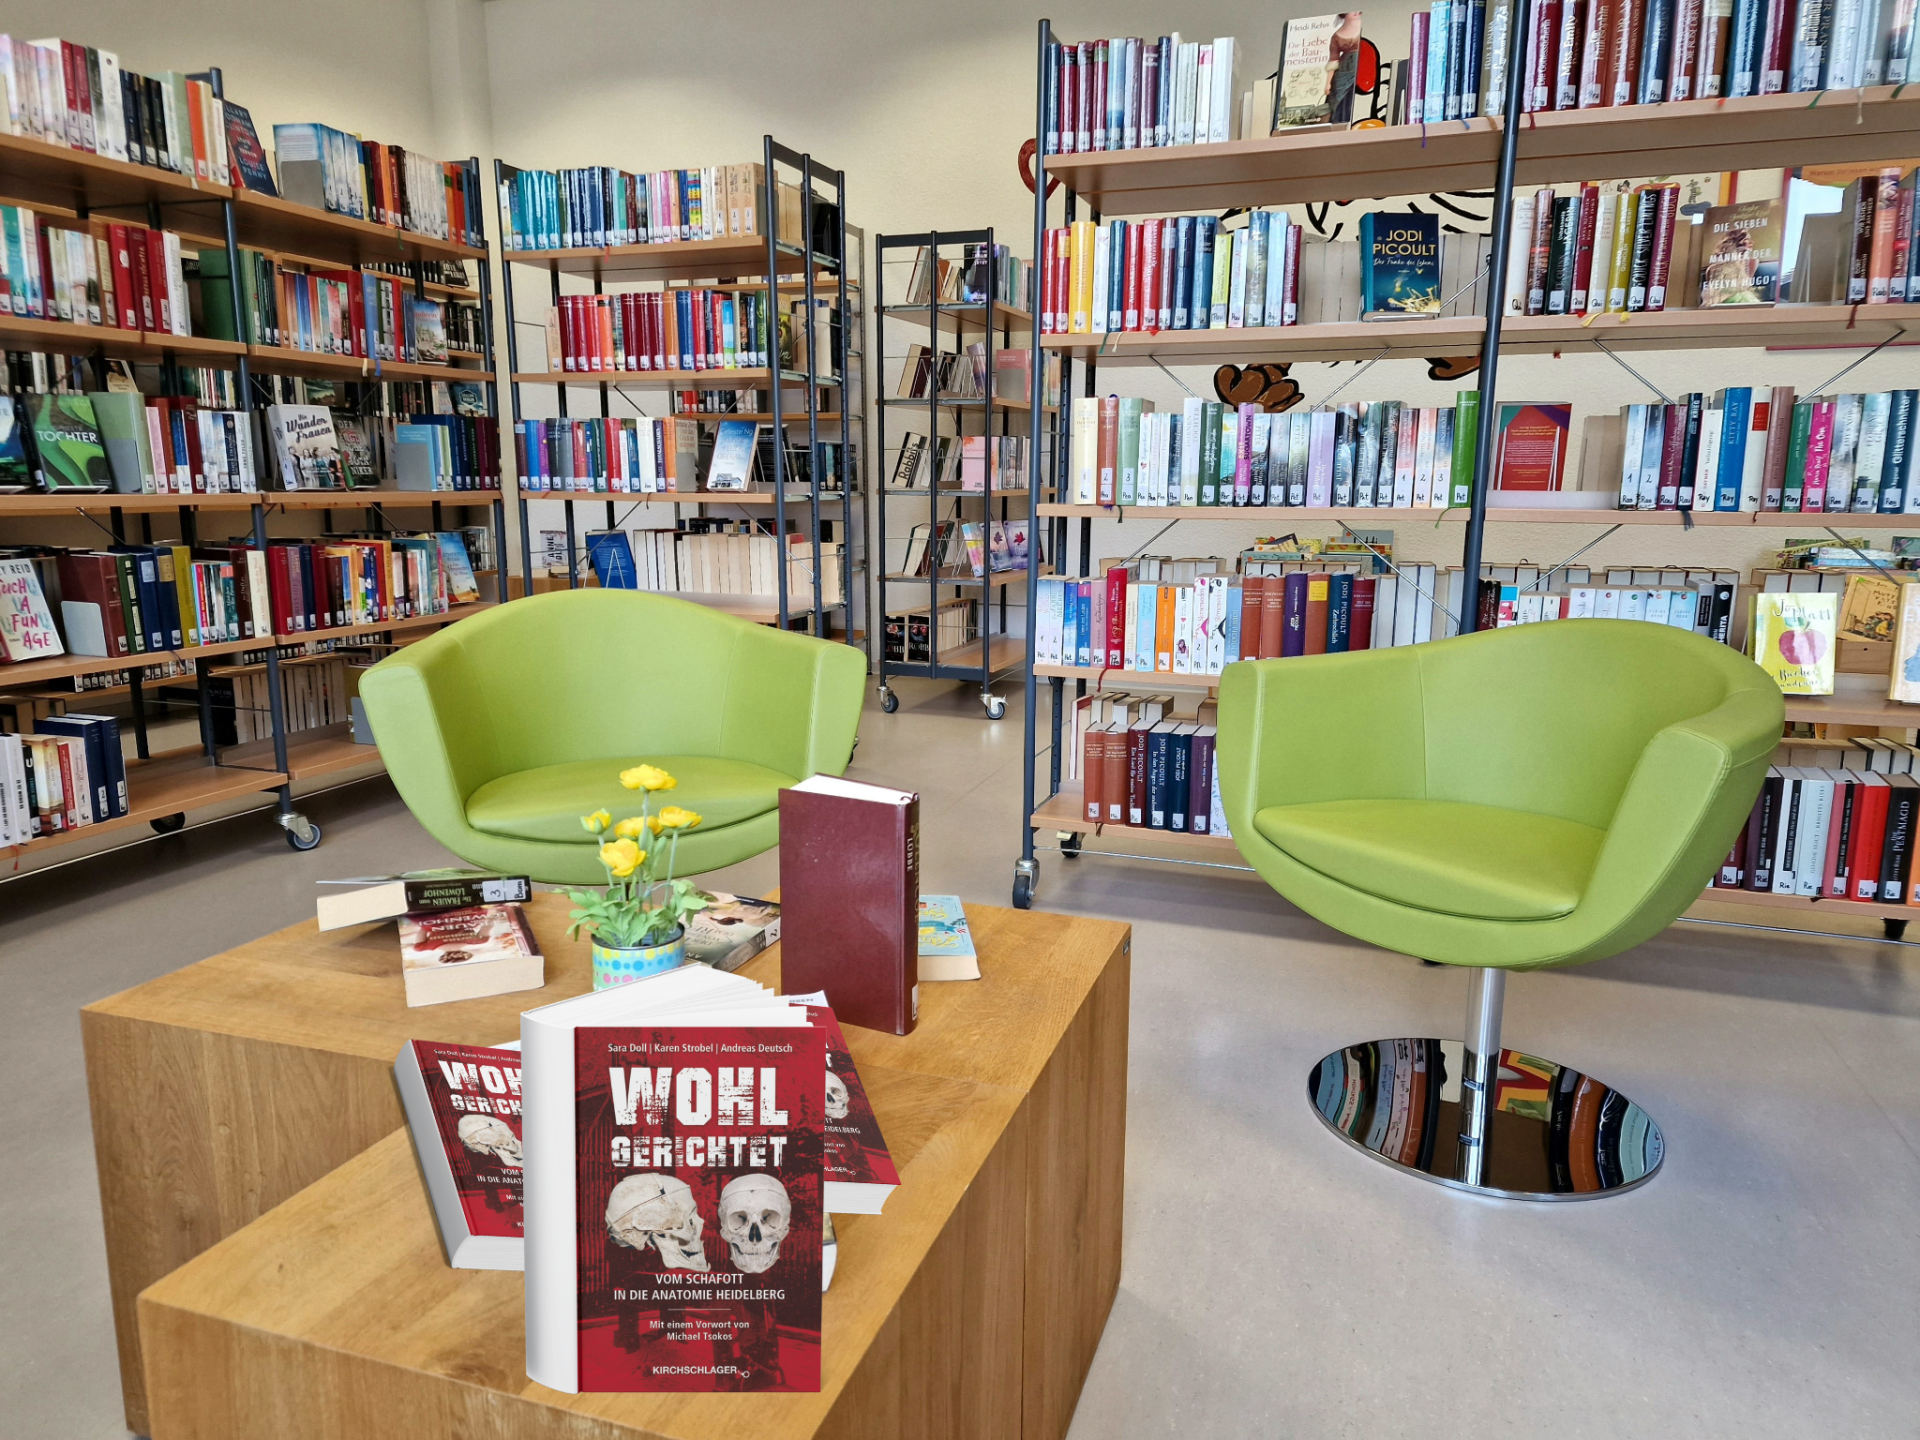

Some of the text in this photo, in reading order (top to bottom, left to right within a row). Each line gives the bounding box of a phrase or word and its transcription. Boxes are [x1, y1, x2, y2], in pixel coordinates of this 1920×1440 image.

[1289, 20, 1330, 32] Heidi Rehn
[1288, 37, 1328, 49] Die Liebe
[1560, 15, 1578, 77] Miss Emily
[1284, 54, 1328, 66] meisterin
[1713, 217, 1768, 233] DIE SIEBEN
[1386, 229, 1422, 242] JODI
[1373, 243, 1436, 256] PICOULT
[1709, 248, 1771, 263] MÄNNER DER
[1373, 257, 1385, 266] Der
[1702, 275, 1769, 291] EVELYN HUGO
[285, 415, 327, 433] Wunder
[36, 430, 98, 443] TOCHTER
[296, 426, 332, 443] Frauen
[1243, 414, 1252, 460] SUGARTOWN
[1103, 472, 1109, 482] 2
[1125, 472, 1131, 482] 3
[1420, 473, 1426, 482] 2
[1438, 473, 1443, 482] 3
[1646, 474, 1652, 483] 2
[20, 595, 31, 614] A
[1340, 581, 1349, 634] JODI PICOULT
[11, 613, 38, 632] FUN
[23, 631, 50, 650] AGE
[1892, 801, 1910, 851] PESTMAGD
[490, 889, 501, 898] 3
[433, 896, 461, 906] FRAUEN
[607, 1043, 793, 1053] Sara Doll Karen Strobel Andreas Deutsch
[438, 1060, 522, 1096] WOH
[609, 1066, 789, 1126] WOHL
[450, 1094, 522, 1115] GERICH
[824, 1126, 861, 1134] EIDELBERG
[611, 1136, 788, 1167] GERICHTET
[487, 1176, 500, 1184] DIE
[655, 1273, 744, 1285] VOM SCHAFOTT
[614, 1289, 785, 1300] IN DIE ANATOMIE HEIDELBERG
[649, 1320, 664, 1329] Mit
[667, 1321, 693, 1329] einem
[695, 1320, 731, 1329] Vorwort
[666, 1332, 733, 1341] Michael Tsokos
[652, 1366, 737, 1375] KIRCHSCHLAGER
